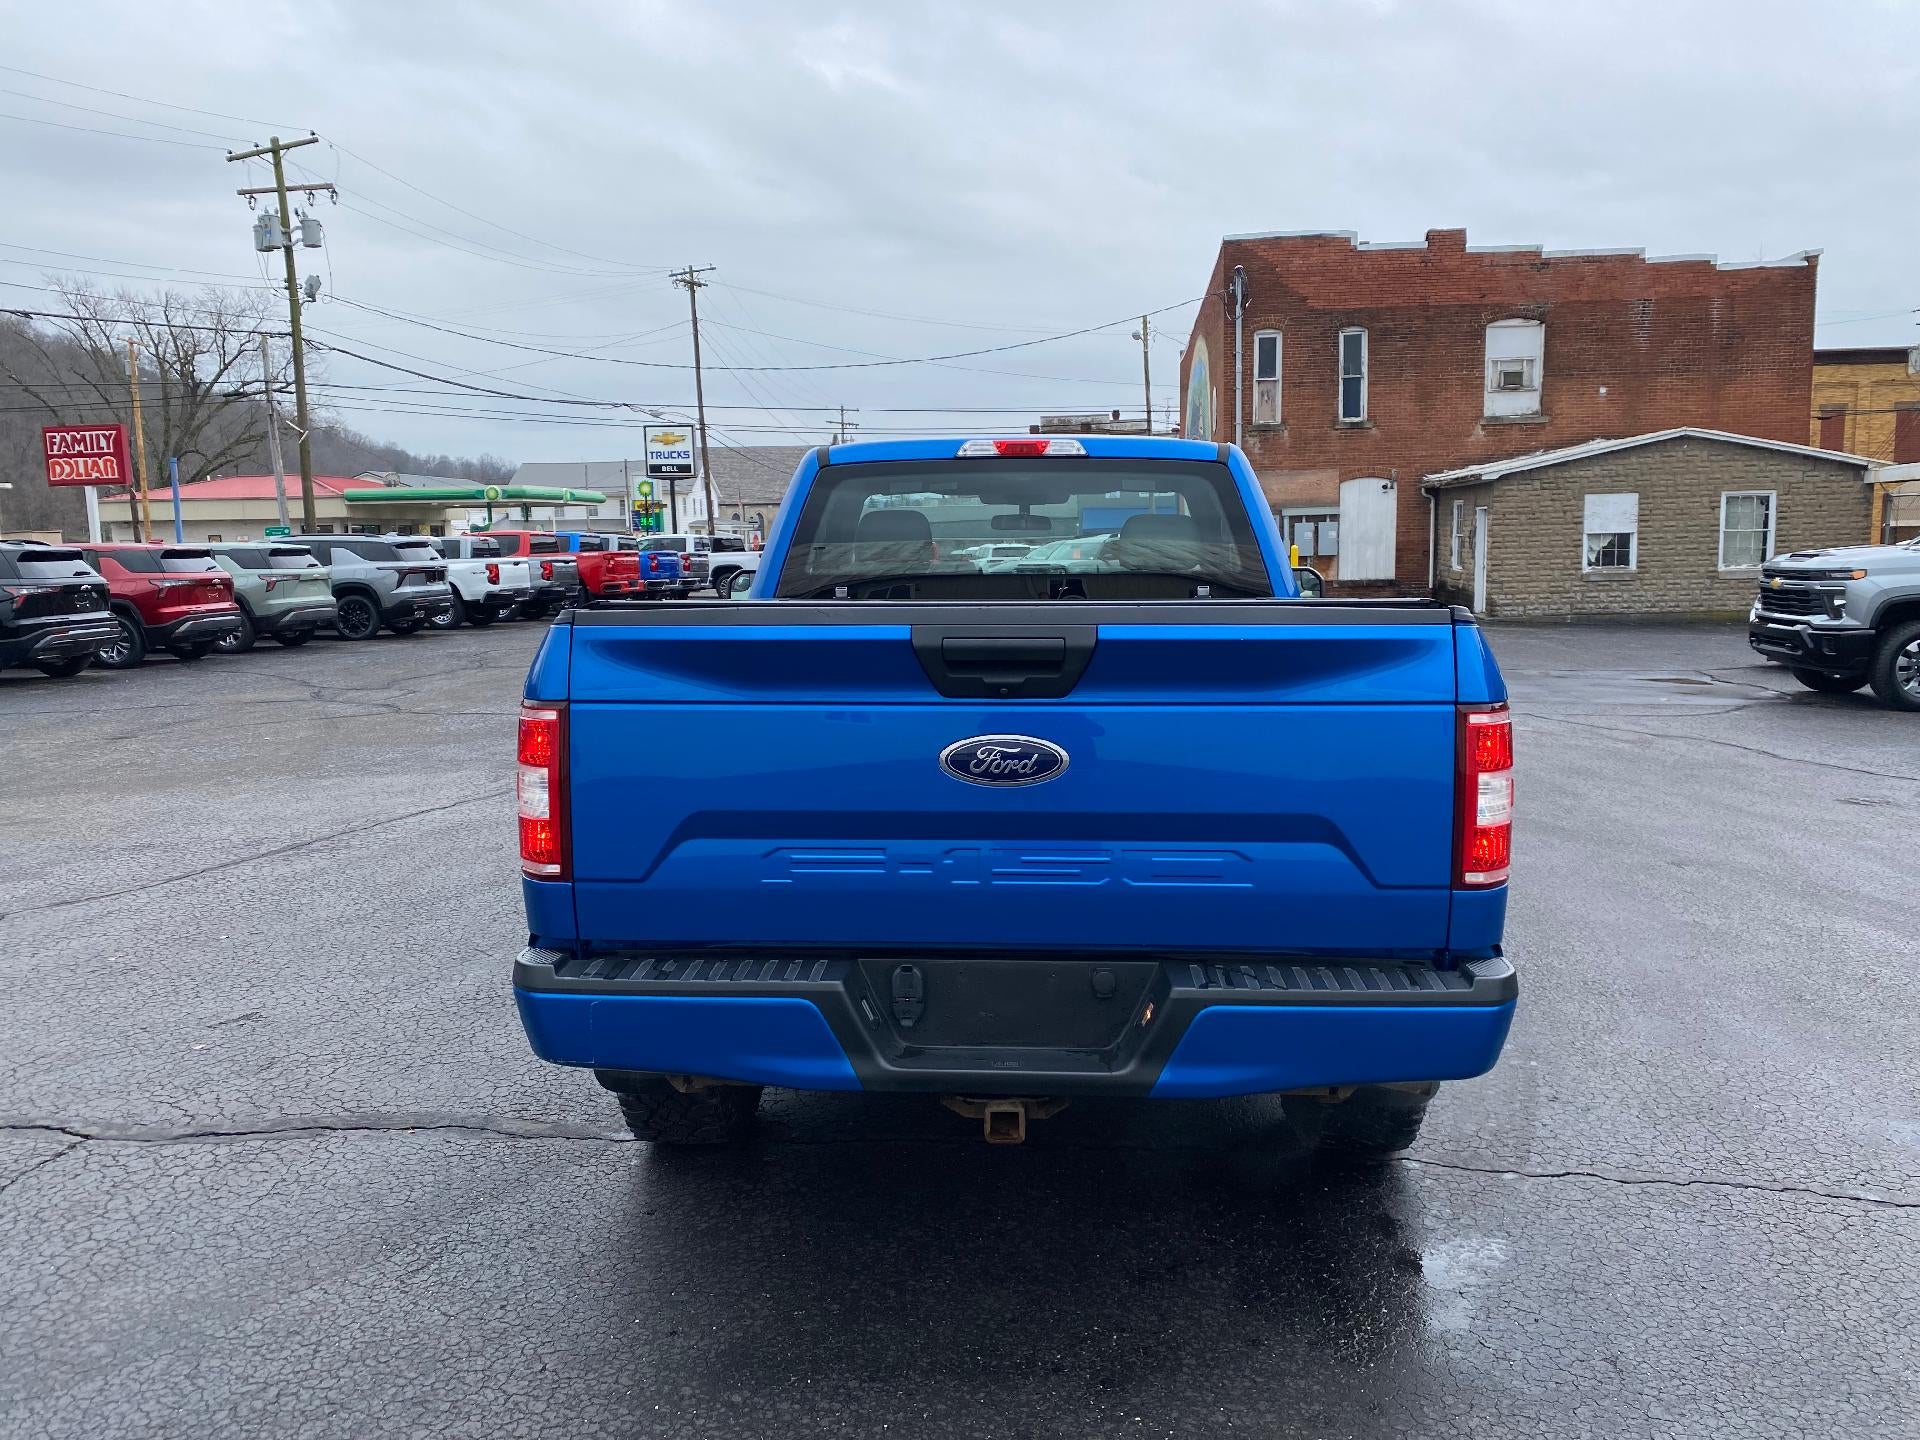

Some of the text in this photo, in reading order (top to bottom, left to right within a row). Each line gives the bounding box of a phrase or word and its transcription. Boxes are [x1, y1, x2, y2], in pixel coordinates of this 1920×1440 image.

[46, 431, 116, 454] FAMILY
[649, 450, 690, 459] TRUCKS
[49, 456, 119, 480] DOLLAR
[969, 745, 1039, 774] Ford
[760, 846, 1254, 888] F-150
